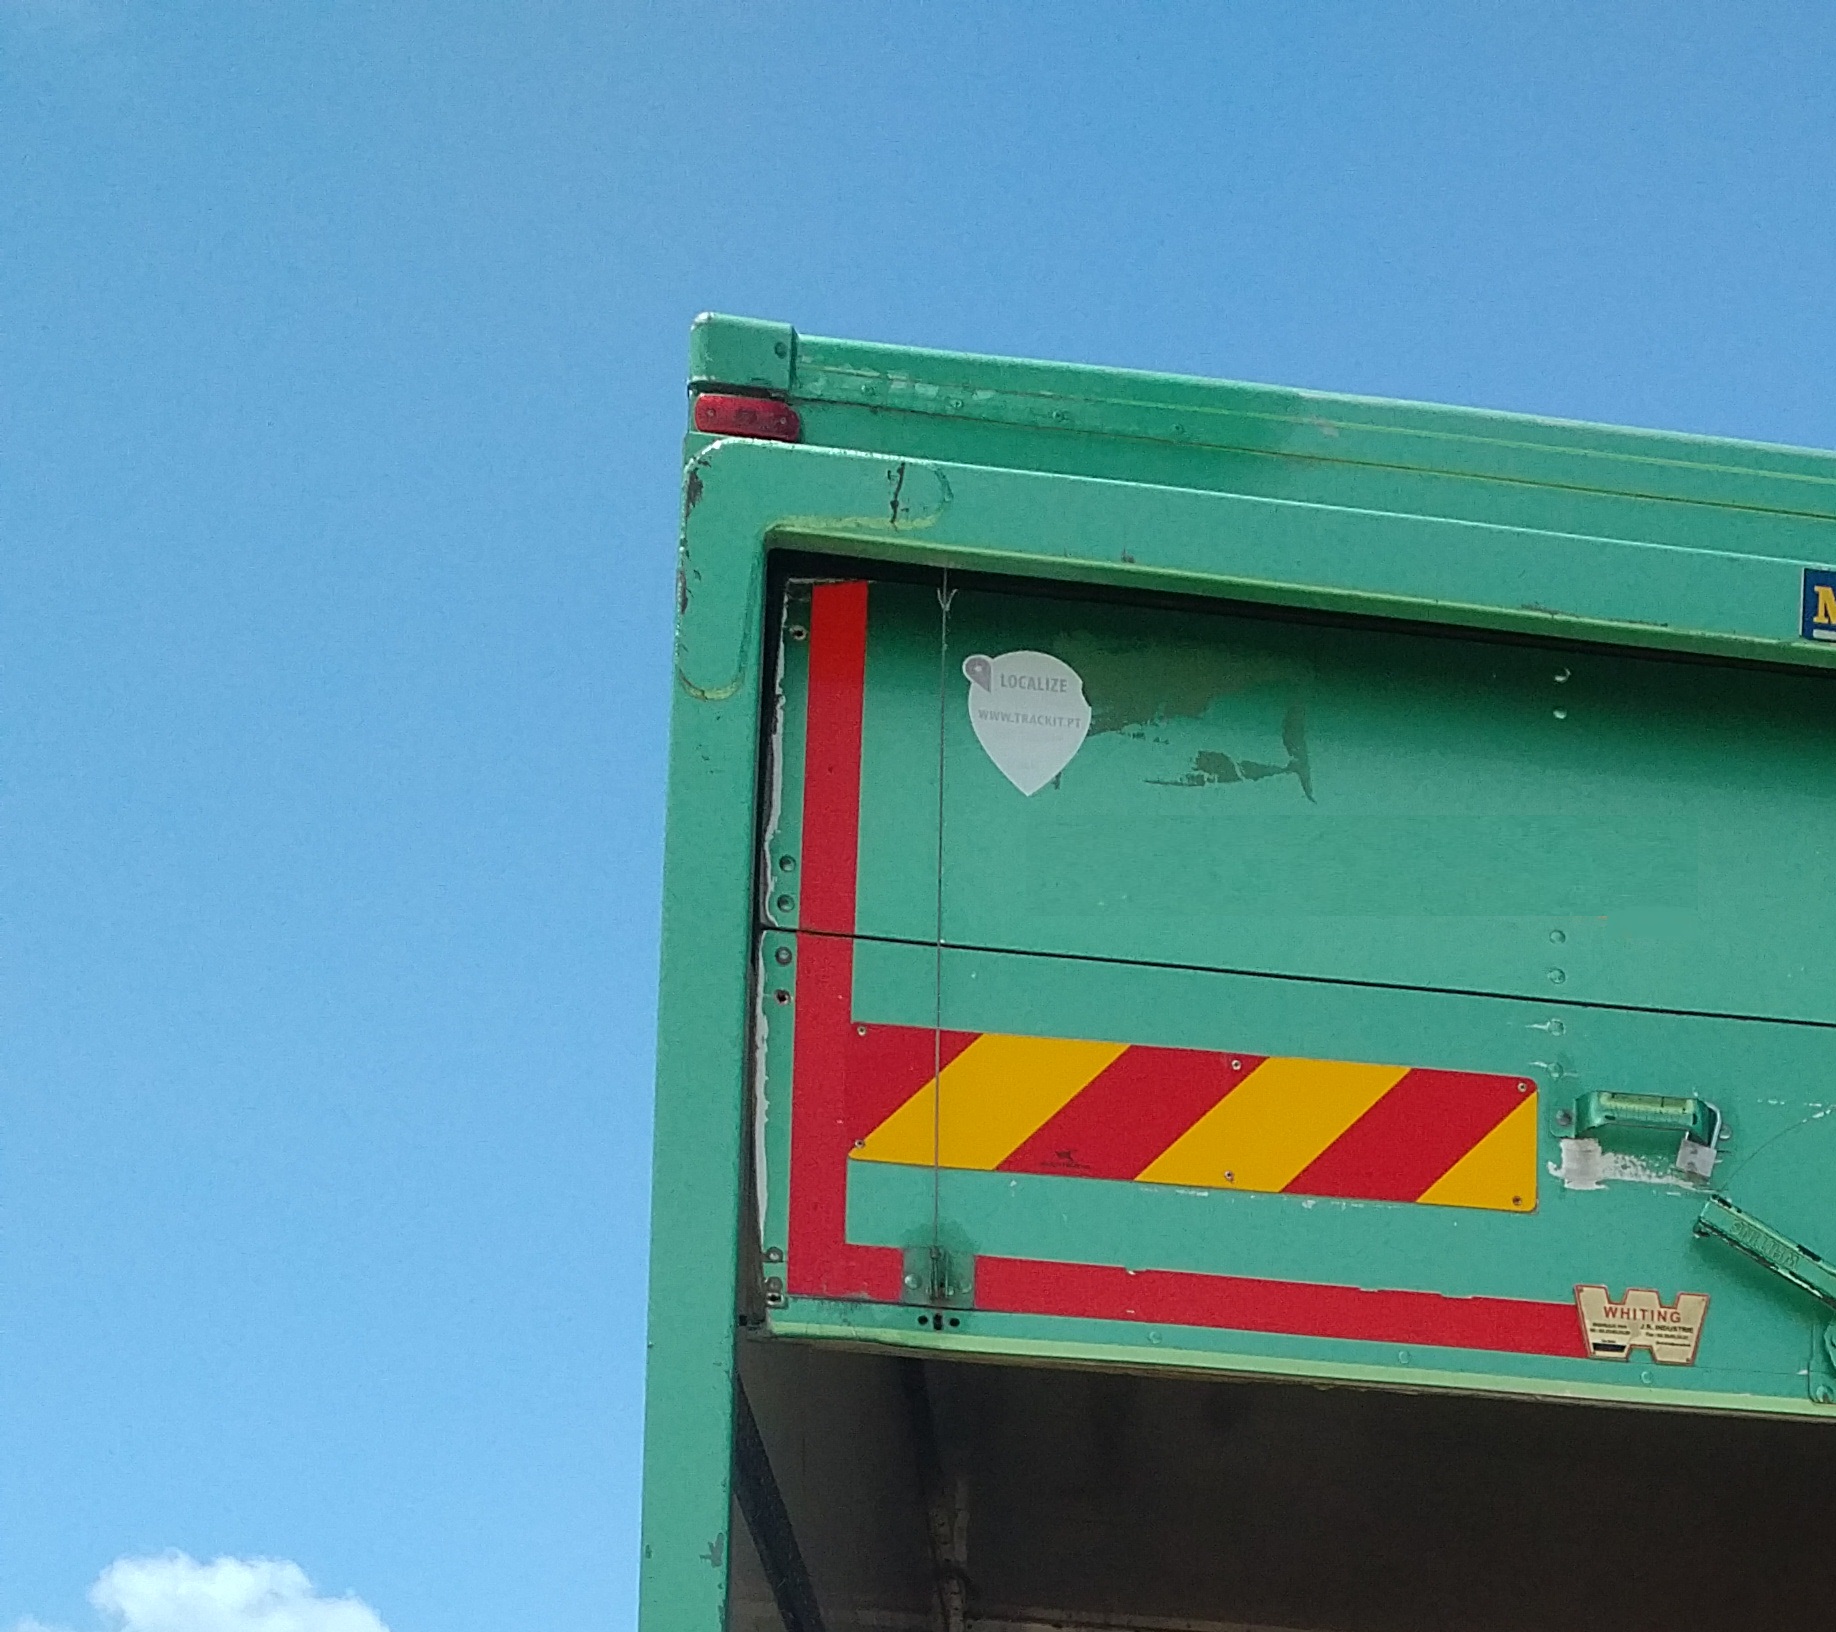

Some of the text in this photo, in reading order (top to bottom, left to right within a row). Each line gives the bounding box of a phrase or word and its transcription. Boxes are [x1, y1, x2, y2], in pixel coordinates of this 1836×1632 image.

[1000, 672, 1068, 694] LOCALIZE
[977, 708, 1082, 729] WWW.TRACKIT.PT
[1603, 1306, 1682, 1324] WHITING
